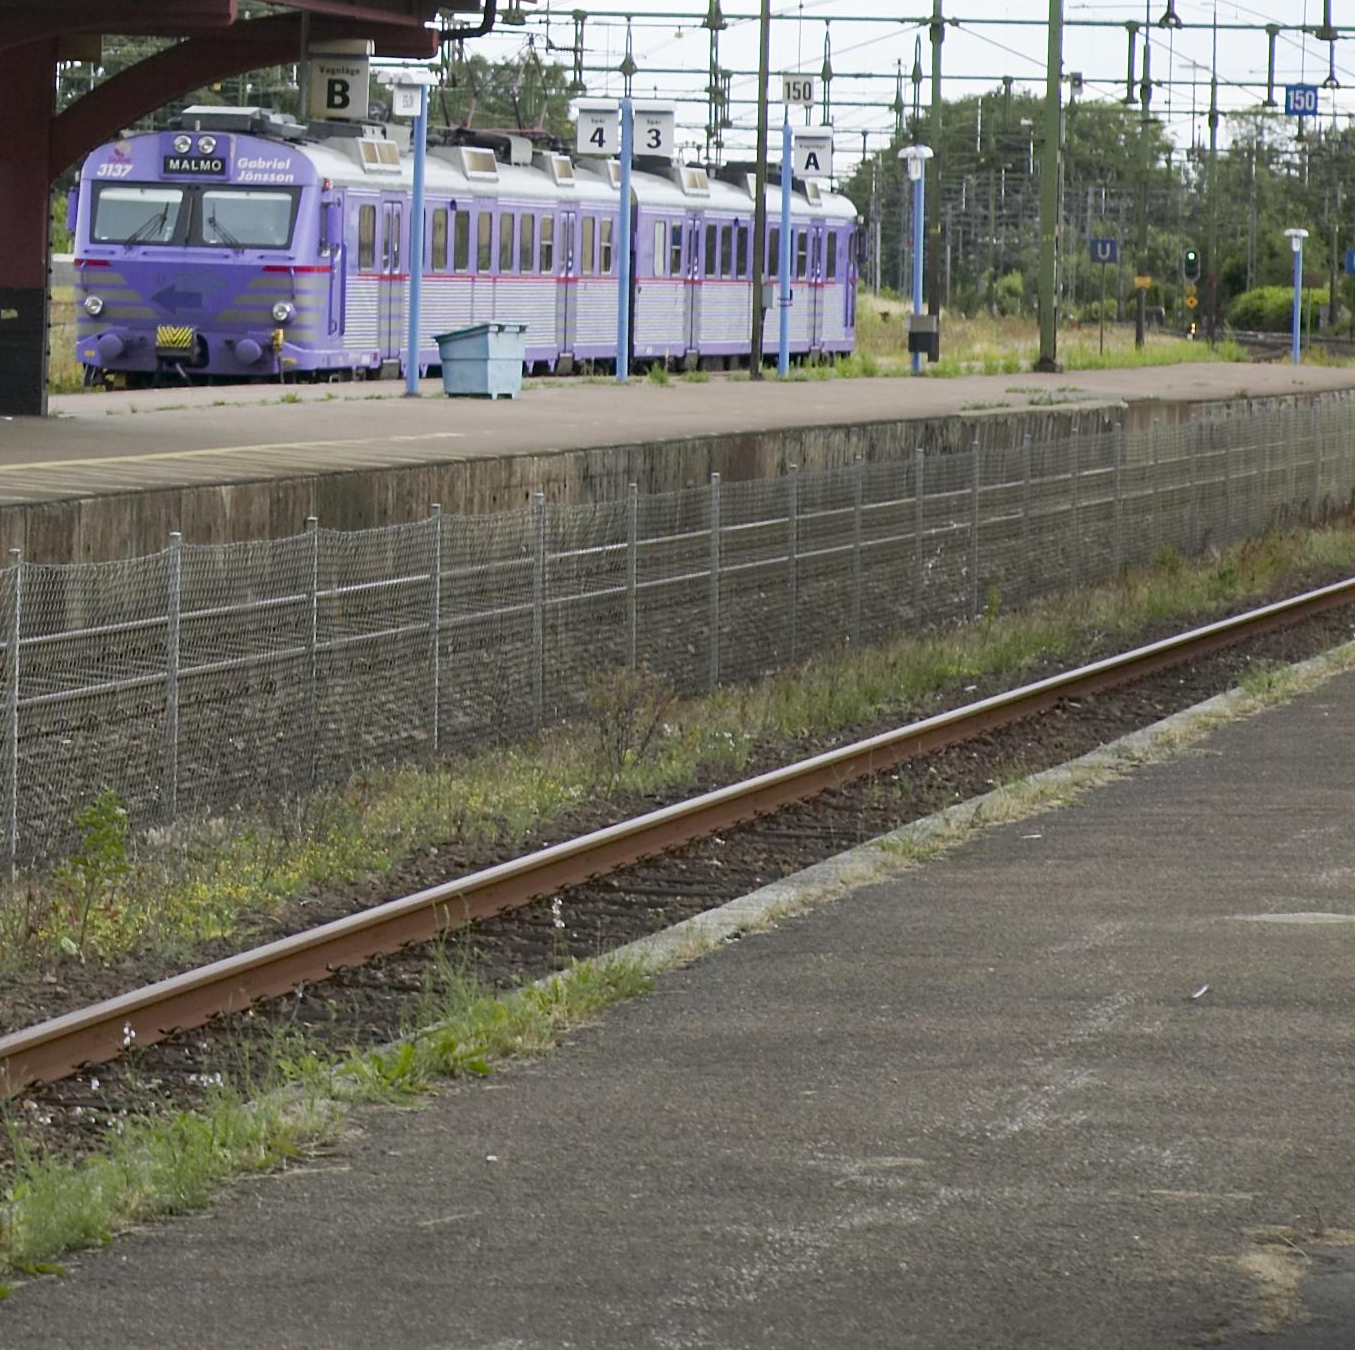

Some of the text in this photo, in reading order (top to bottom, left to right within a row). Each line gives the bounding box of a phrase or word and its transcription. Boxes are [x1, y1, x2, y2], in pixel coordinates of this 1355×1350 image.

[326, 78, 350, 109] B
[785, 81, 812, 101] 150
[1288, 90, 1316, 111] 150
[589, 127, 606, 148] 4
[646, 128, 662, 149] 3
[97, 163, 134, 178] 3137
[237, 157, 292, 170] Gabriel
[804, 152, 820, 171] A
[236, 170, 295, 183] Jönsson
[1097, 242, 1111, 260] U
